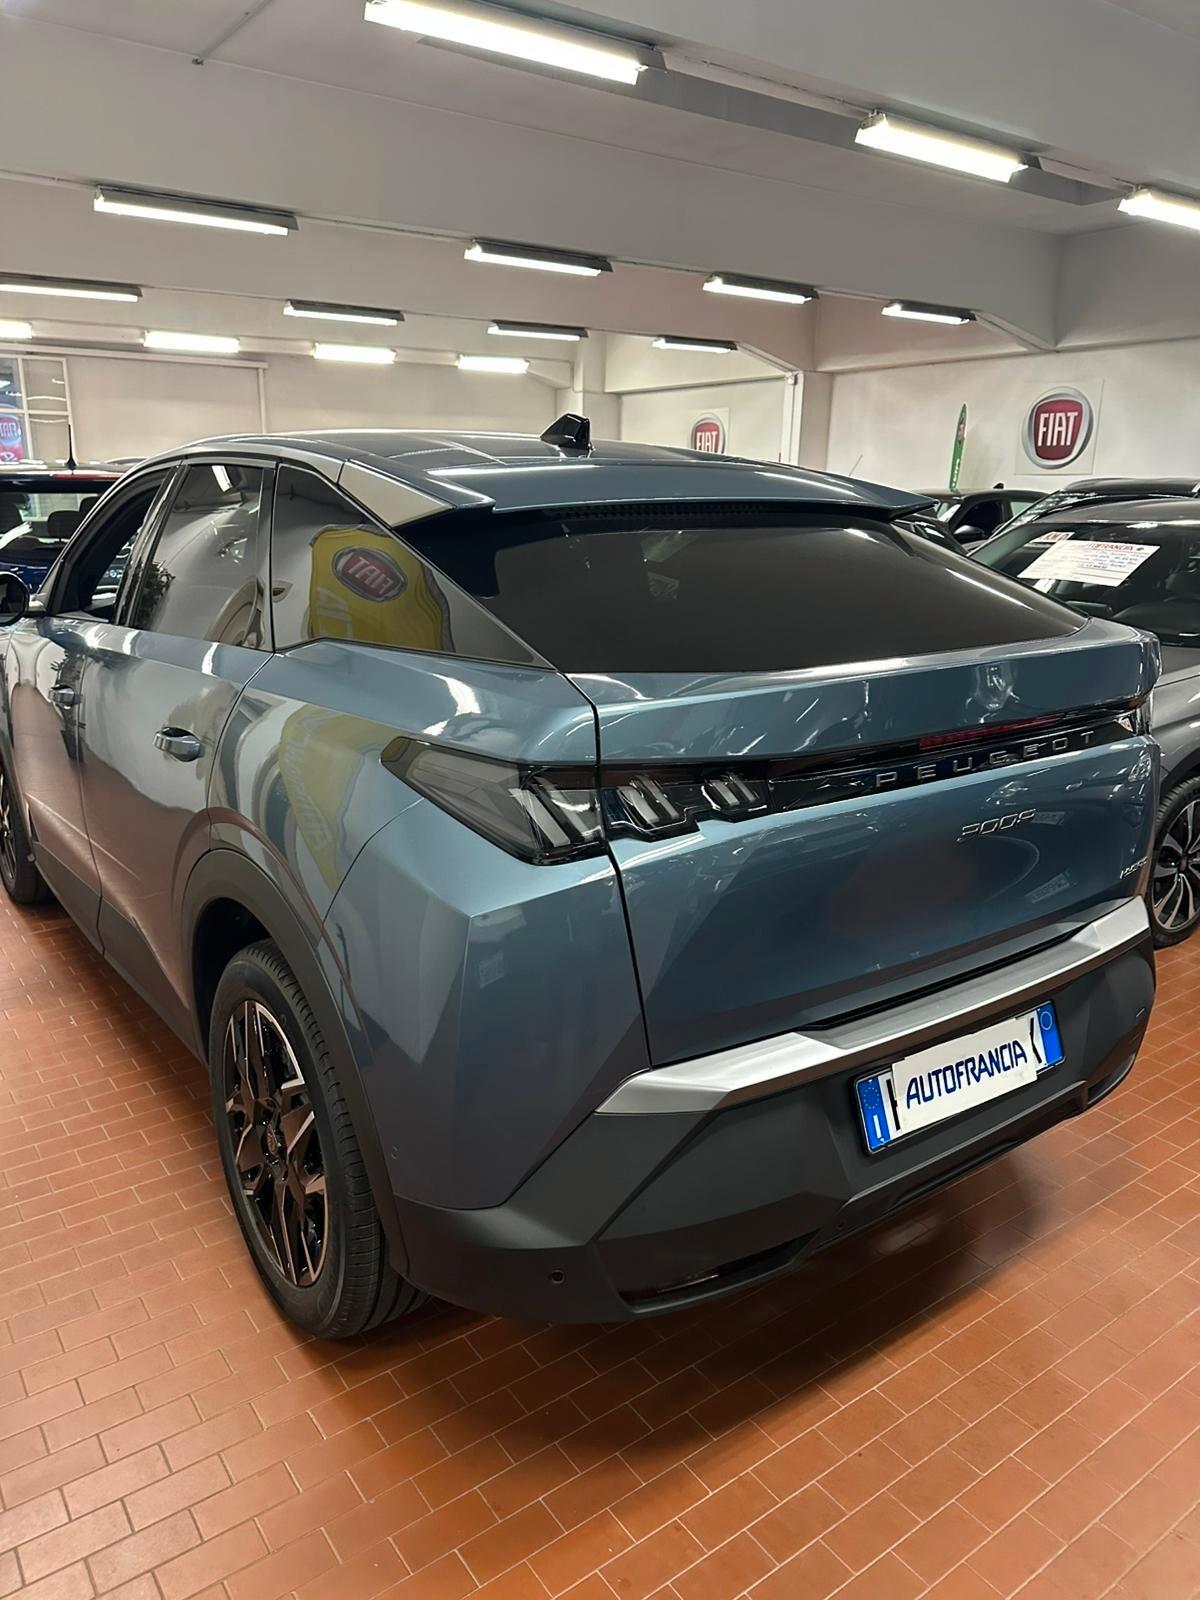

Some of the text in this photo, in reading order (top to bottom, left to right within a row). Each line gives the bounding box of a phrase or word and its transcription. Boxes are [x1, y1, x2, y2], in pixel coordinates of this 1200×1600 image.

[696, 431, 718, 453] FIAT
[1037, 411, 1079, 447] FIAT
[876, 730, 1095, 788] PEUGEOT
[906, 1040, 1027, 1110] AUTOFRANCIA
[872, 1114, 883, 1139] I
